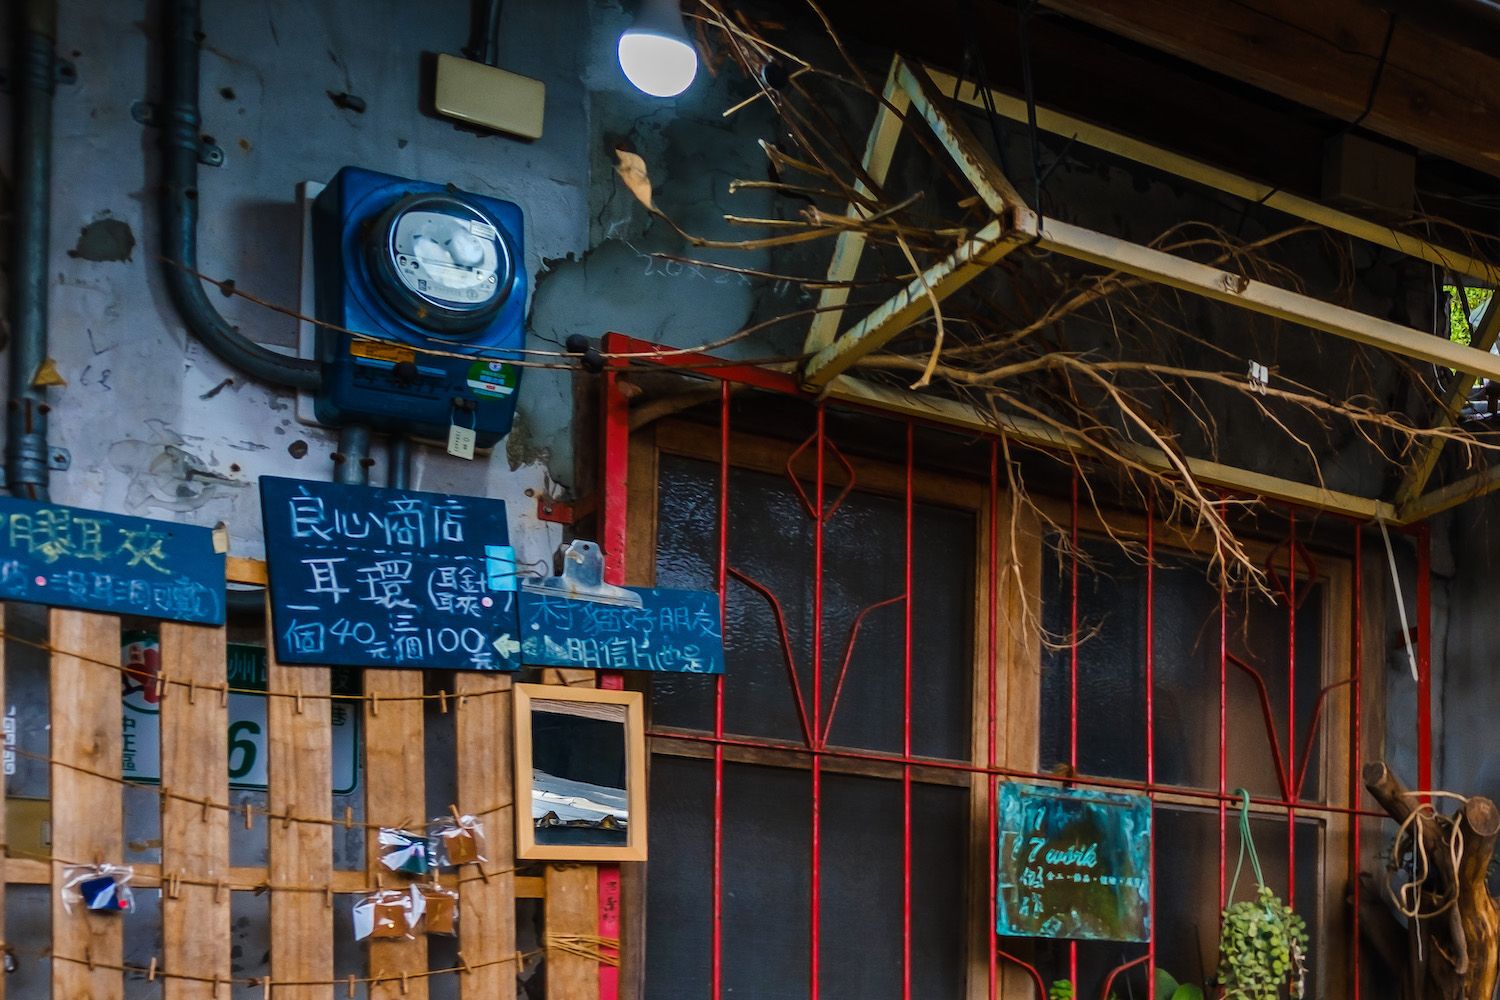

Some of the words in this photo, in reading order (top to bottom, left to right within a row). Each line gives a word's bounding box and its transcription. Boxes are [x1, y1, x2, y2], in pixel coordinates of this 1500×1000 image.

[288, 485, 467, 548] 良心商店
[300, 557, 418, 609] 耳環
[228, 720, 261, 779] 6
